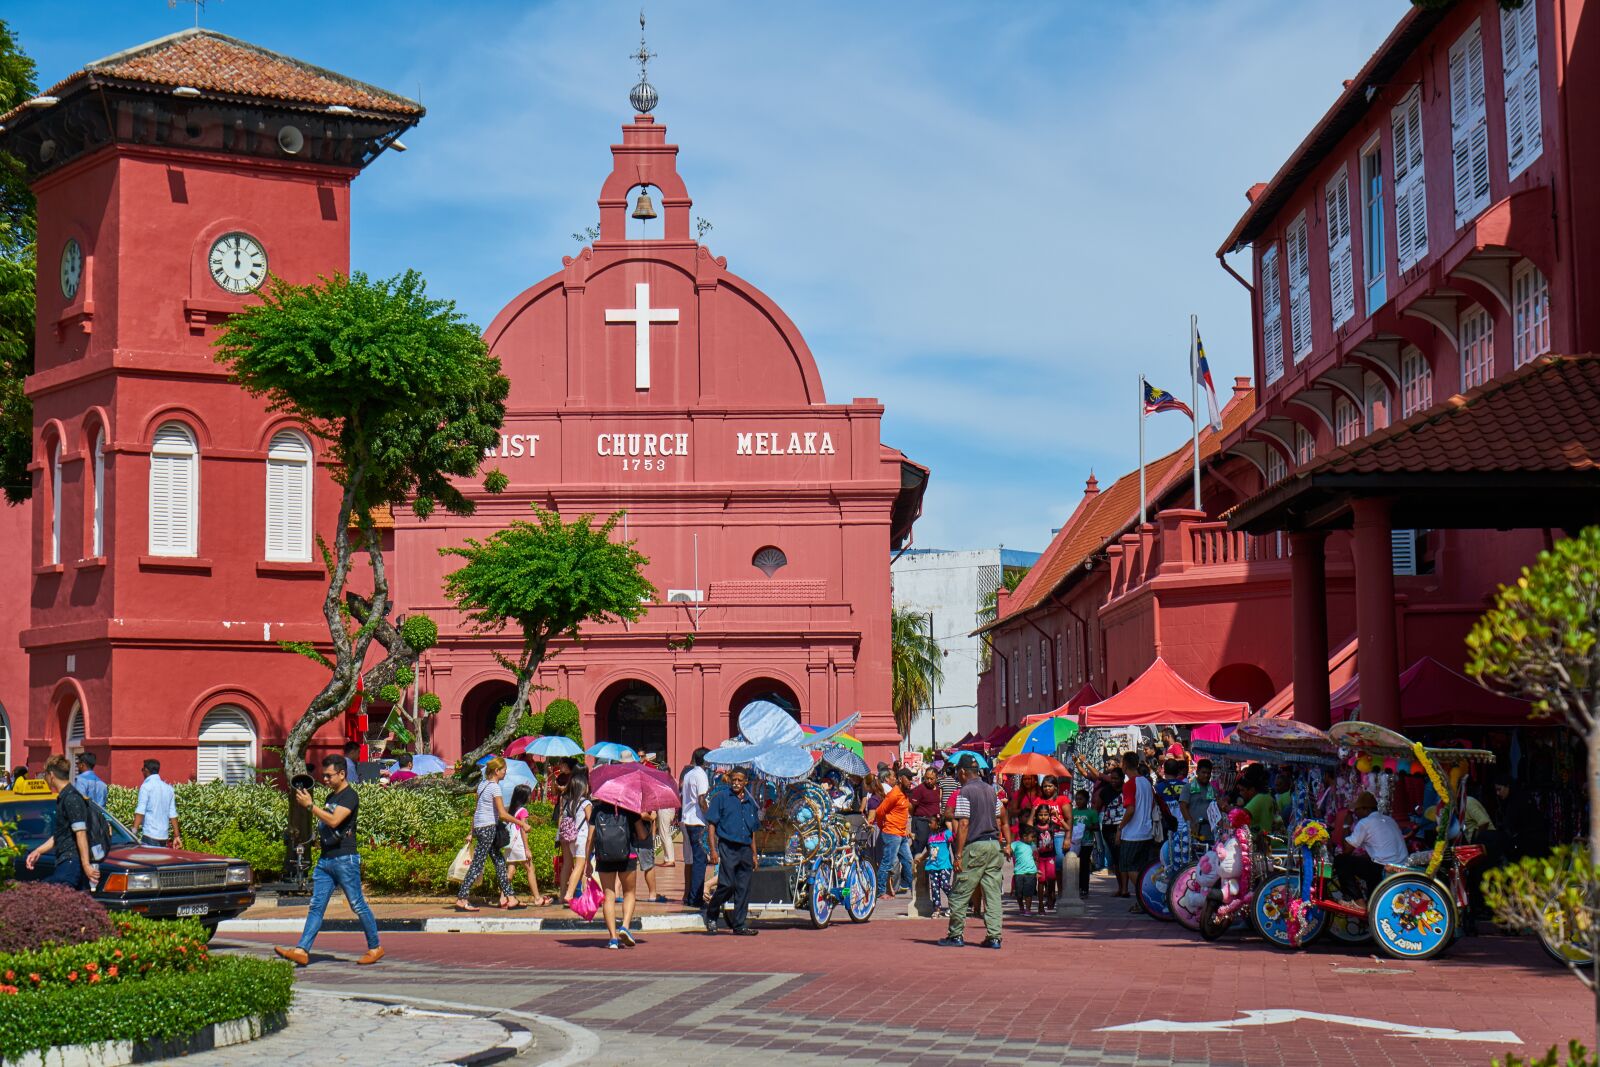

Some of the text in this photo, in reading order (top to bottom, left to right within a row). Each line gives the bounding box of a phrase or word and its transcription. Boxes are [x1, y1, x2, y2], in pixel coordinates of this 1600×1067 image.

[597, 433, 689, 456] CHURCH
[736, 432, 835, 455] MELAKA
[622, 459, 666, 472] 1753
[1380, 918, 1422, 951] ANGRY BIRDS
